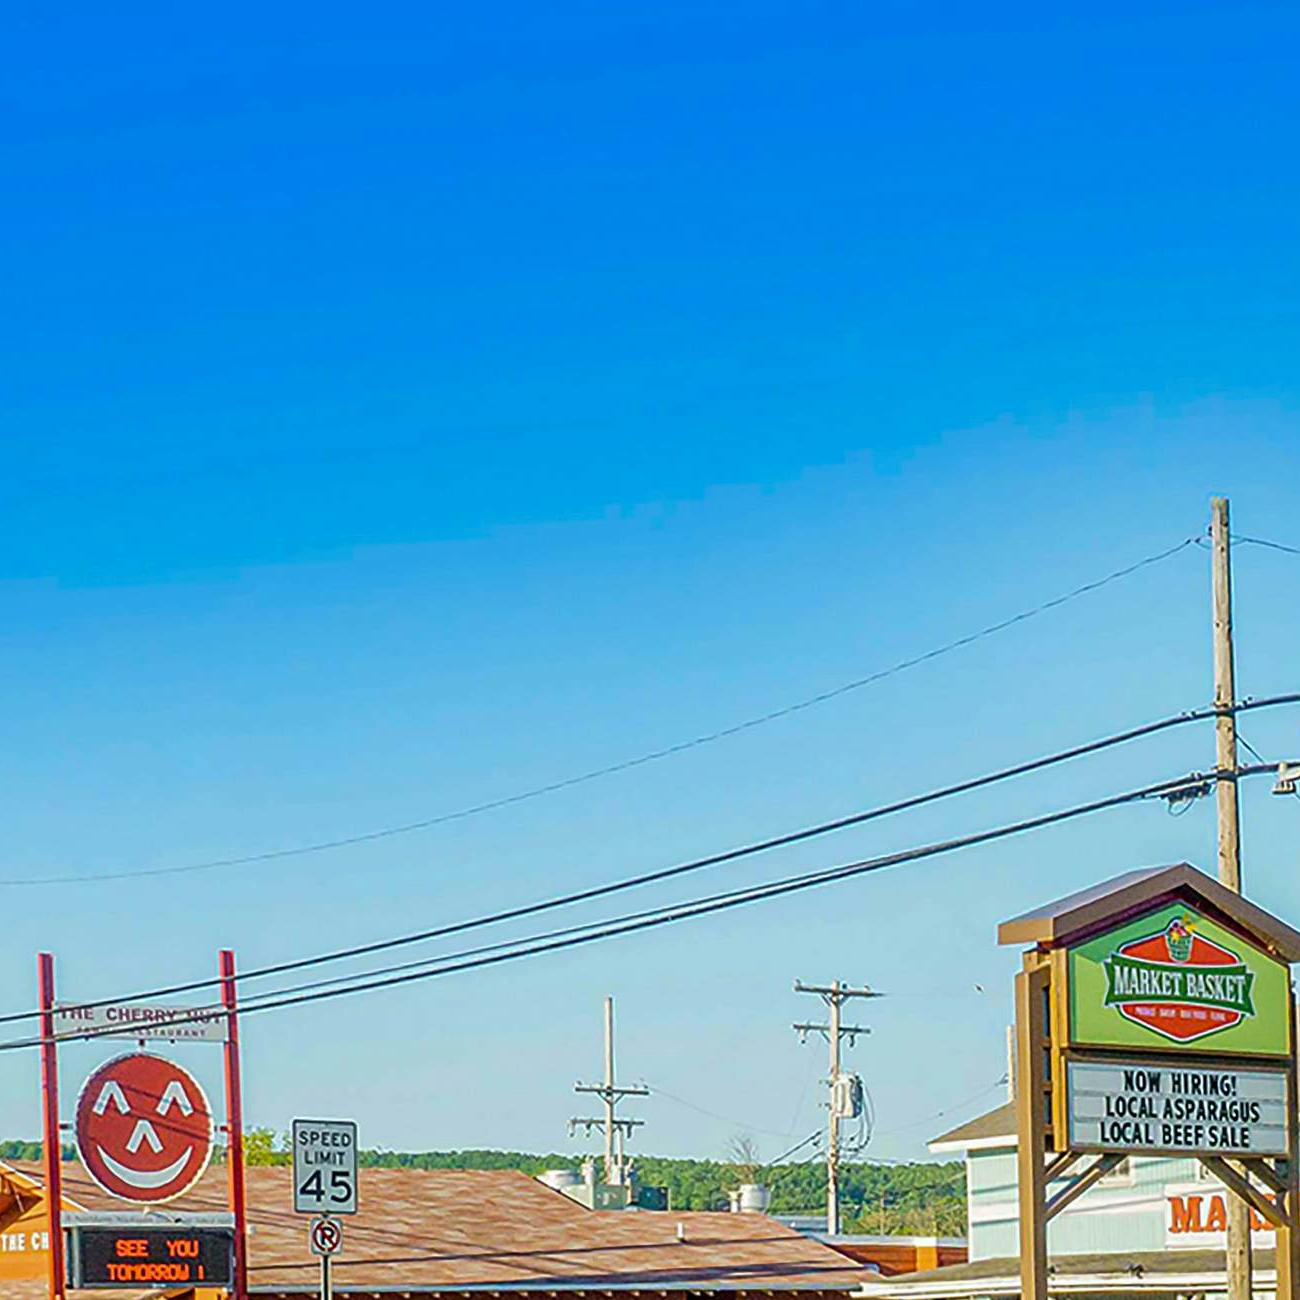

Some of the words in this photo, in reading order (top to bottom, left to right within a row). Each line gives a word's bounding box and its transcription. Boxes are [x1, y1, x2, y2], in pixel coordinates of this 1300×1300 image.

[1114, 965, 1182, 995] MARKET
[1186, 974, 1245, 1004] BASKET
[58, 1004, 94, 1020] THE
[106, 1007, 178, 1023] CHERRY
[1124, 1070, 1161, 1092] NOW
[1171, 1073, 1237, 1096] HIRING!
[1105, 1096, 1158, 1118] LOCAL
[1163, 1099, 1260, 1123] ASPARAGUS
[299, 1130, 352, 1147] SPEED
[1100, 1121, 1154, 1144] LOCAL
[1162, 1124, 1203, 1145] BEEF
[1208, 1126, 1250, 1147] SALE
[304, 1150, 346, 1165] LIMIT
[299, 1169, 352, 1203] 45
[0, 1233, 25, 1251] THE
[115, 1239, 148, 1257] SEE
[167, 1239, 199, 1257] YOU
[106, 1263, 190, 1280] TOMORROW
